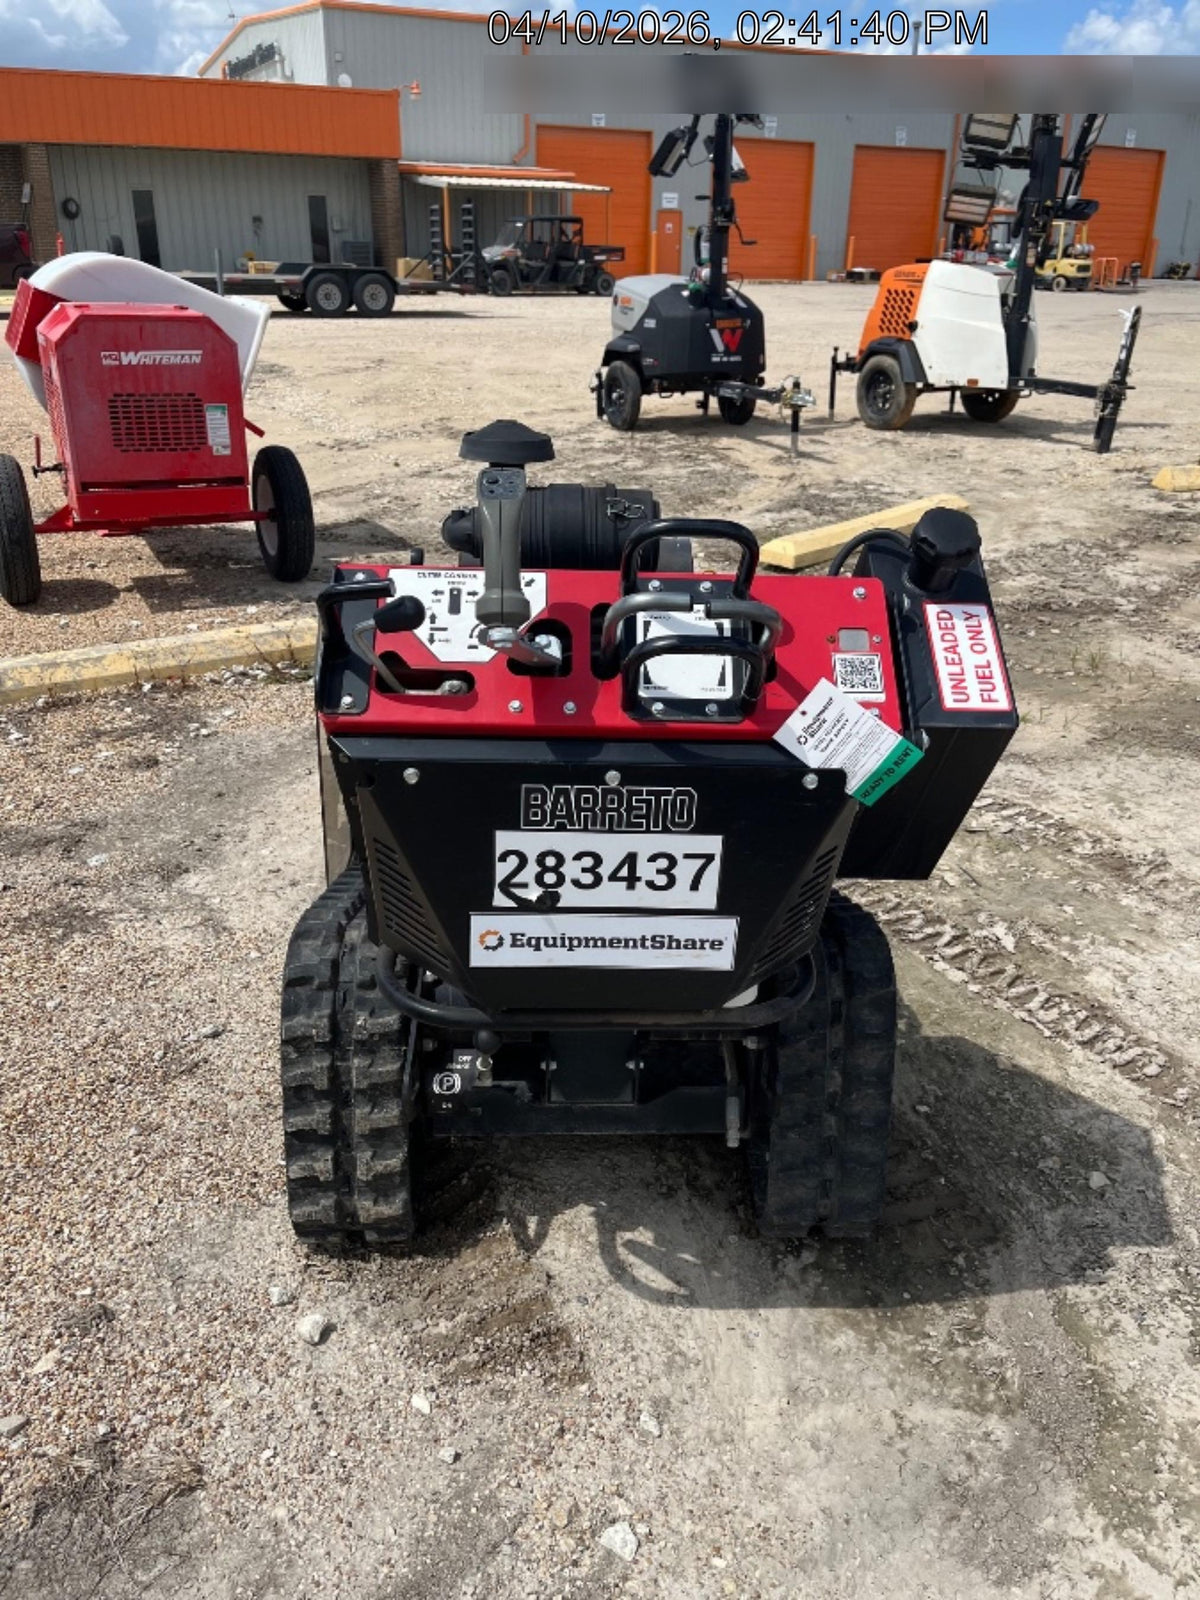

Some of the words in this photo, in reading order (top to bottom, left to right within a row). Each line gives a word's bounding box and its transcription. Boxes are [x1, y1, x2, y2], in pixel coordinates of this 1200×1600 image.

[961, 610, 988, 655] ONLY
[936, 609, 970, 703] UNLEADED
[974, 659, 1000, 703] FUEL
[520, 783, 698, 831] BARRETO
[497, 848, 716, 893] 283437
[509, 932, 724, 952] EquipmentShare
